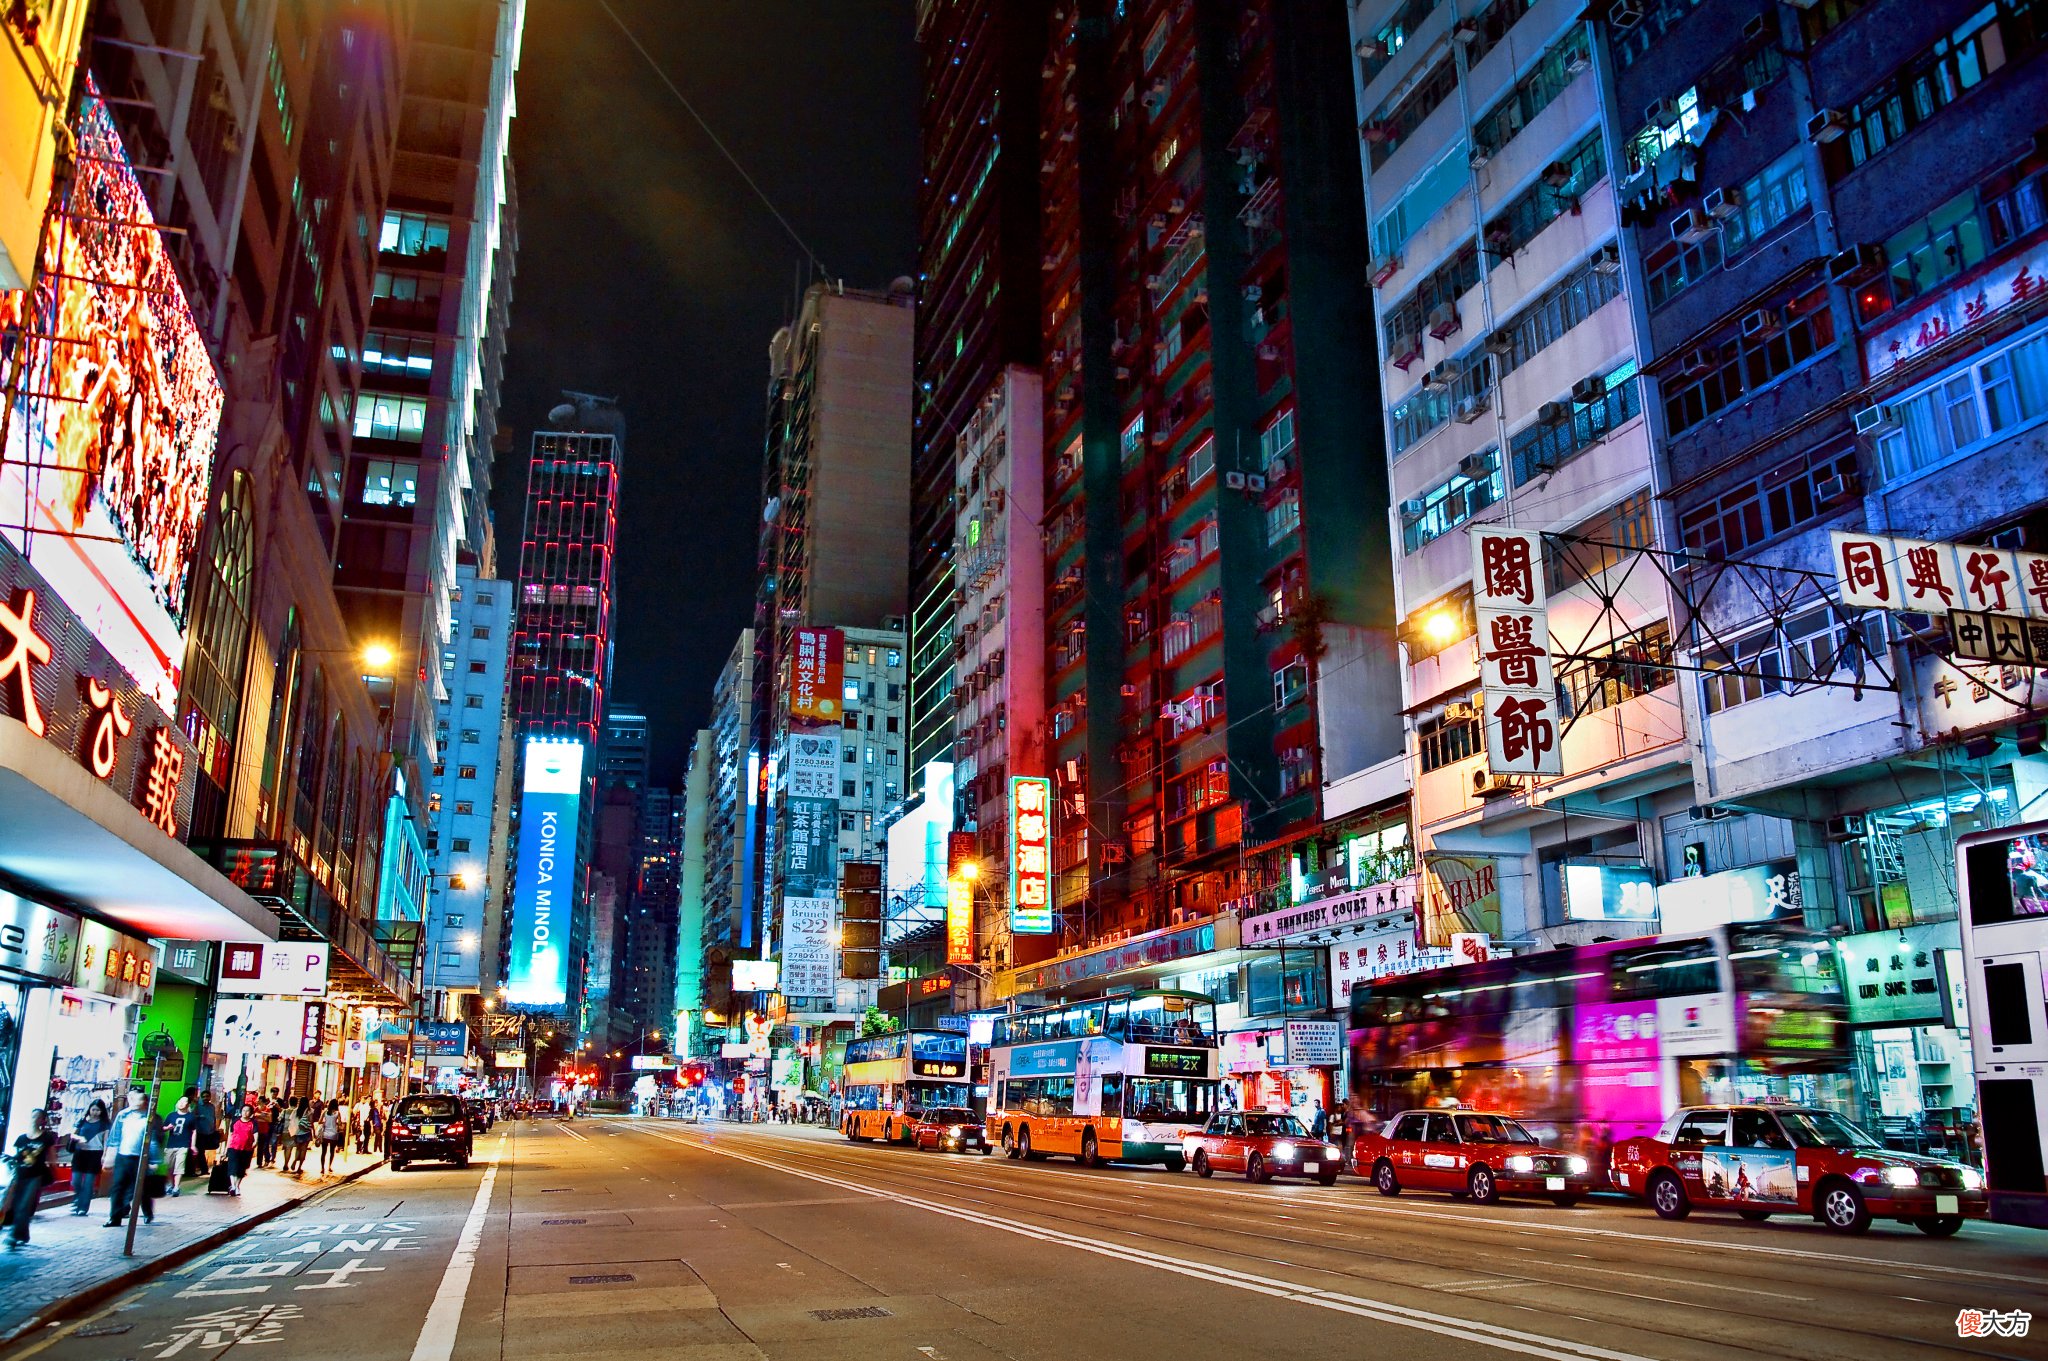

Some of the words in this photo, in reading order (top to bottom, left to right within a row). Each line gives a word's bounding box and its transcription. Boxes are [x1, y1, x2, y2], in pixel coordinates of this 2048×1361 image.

[537, 811, 558, 885] KONICA
[790, 801, 810, 870] 紅茶館酒店
[791, 909, 828, 918] Brunch
[791, 918, 828, 934] $22
[1276, 907, 1327, 930] HENNESSY
[1332, 897, 1368, 917] COURT
[530, 889, 552, 970] MINOL
[305, 954, 321, 972] P
[1339, 939, 1452, 971] 隆豐參茸
[1182, 1060, 1198, 1070] 2X
[278, 1221, 422, 1239] BUS
[225, 1235, 428, 1259] LANE
[173, 1258, 386, 1299] 巴士
